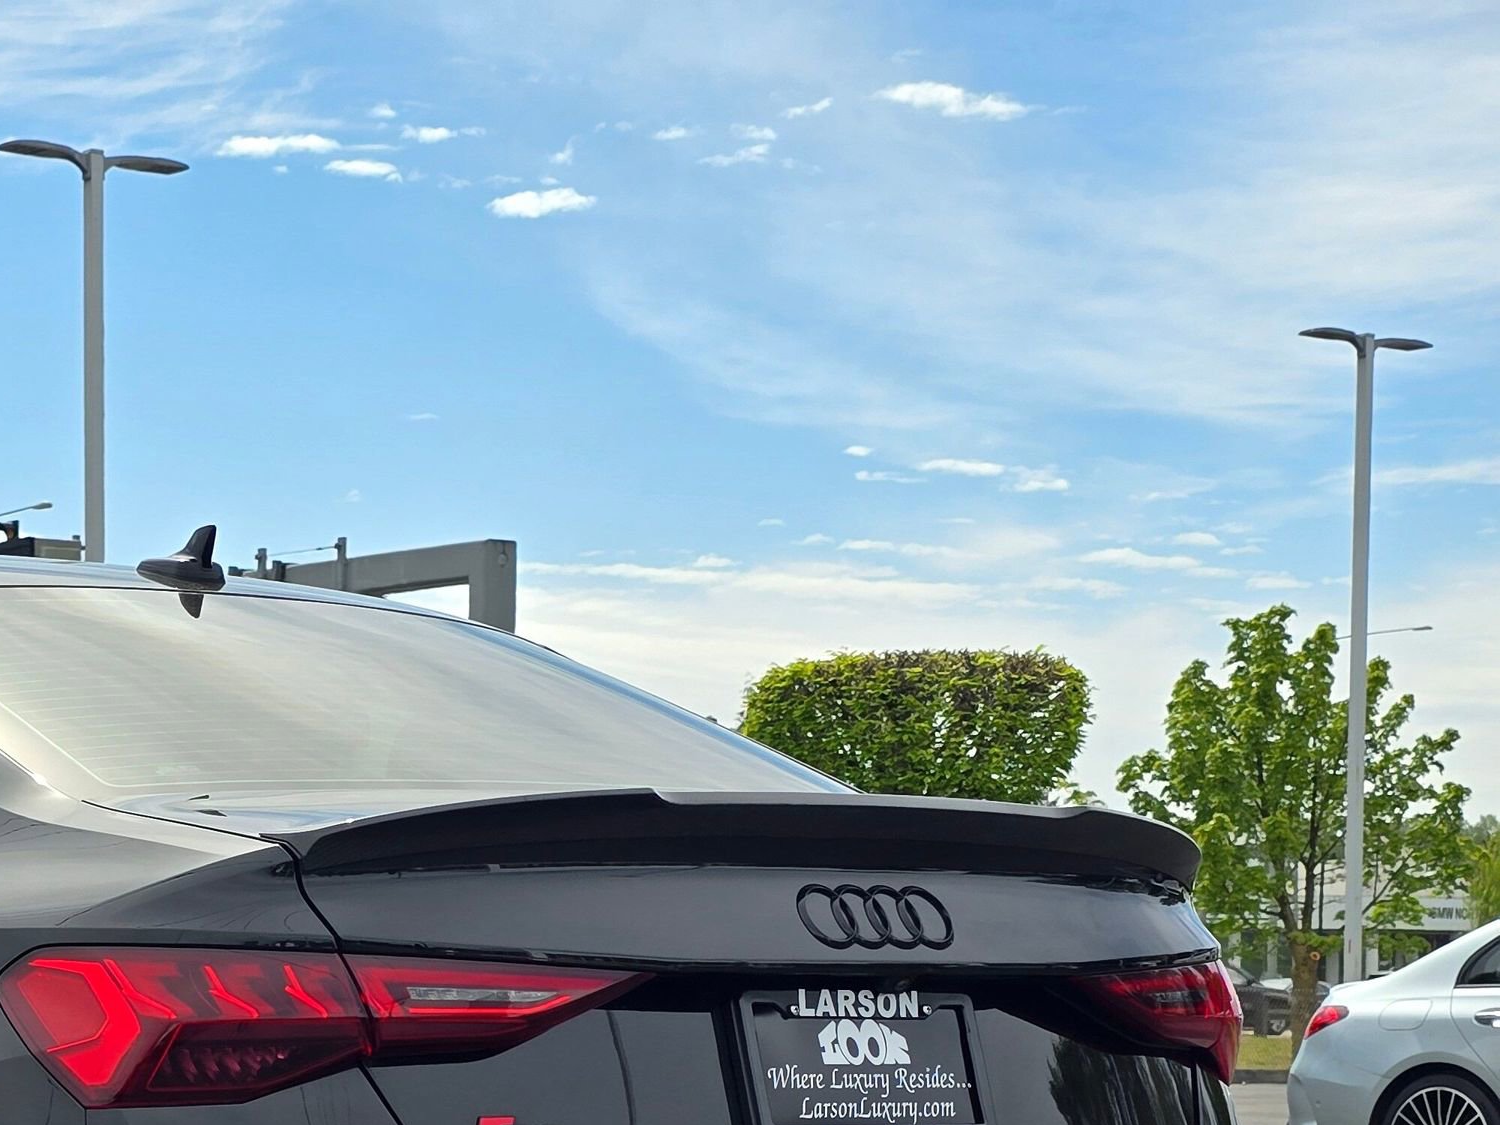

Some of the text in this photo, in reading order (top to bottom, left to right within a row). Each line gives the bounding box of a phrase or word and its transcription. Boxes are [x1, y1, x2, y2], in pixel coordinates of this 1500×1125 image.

[797, 988, 920, 1019] LARSON
[767, 1064, 973, 1098] Where Luxury Resides...
[799, 1096, 956, 1125] LarsonLuxury.com
